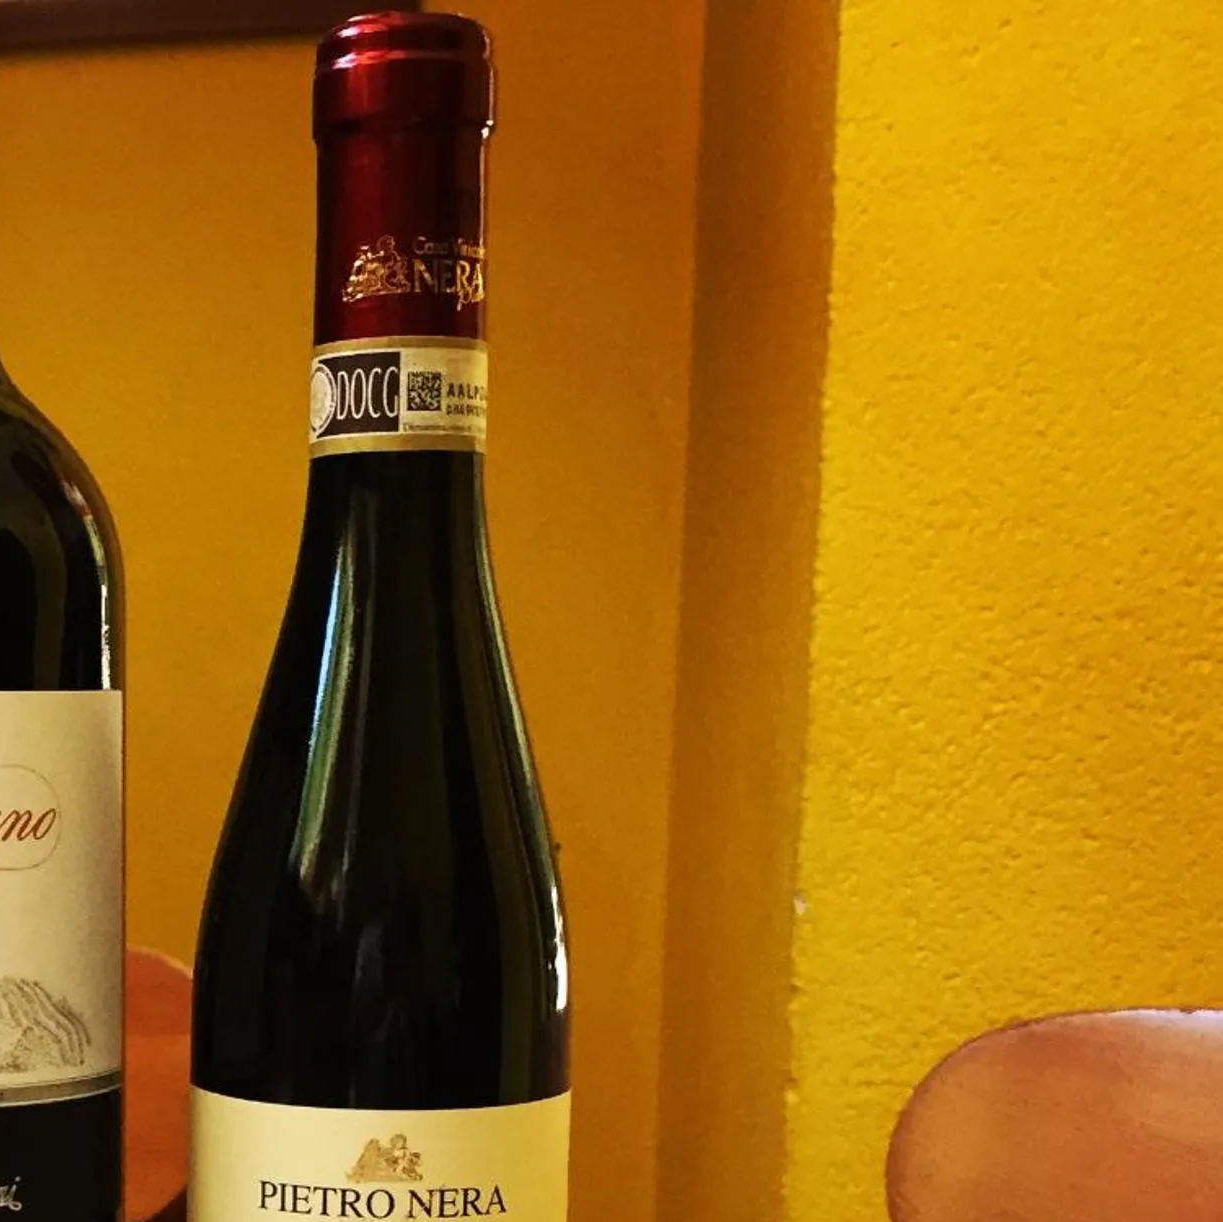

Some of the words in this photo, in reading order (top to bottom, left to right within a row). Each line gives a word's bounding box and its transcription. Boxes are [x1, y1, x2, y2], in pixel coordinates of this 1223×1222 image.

[412, 258, 485, 299] NERA
[335, 365, 400, 421] DOCG
[257, 1179, 396, 1219] PIETRO
[407, 1184, 508, 1219] NERA
